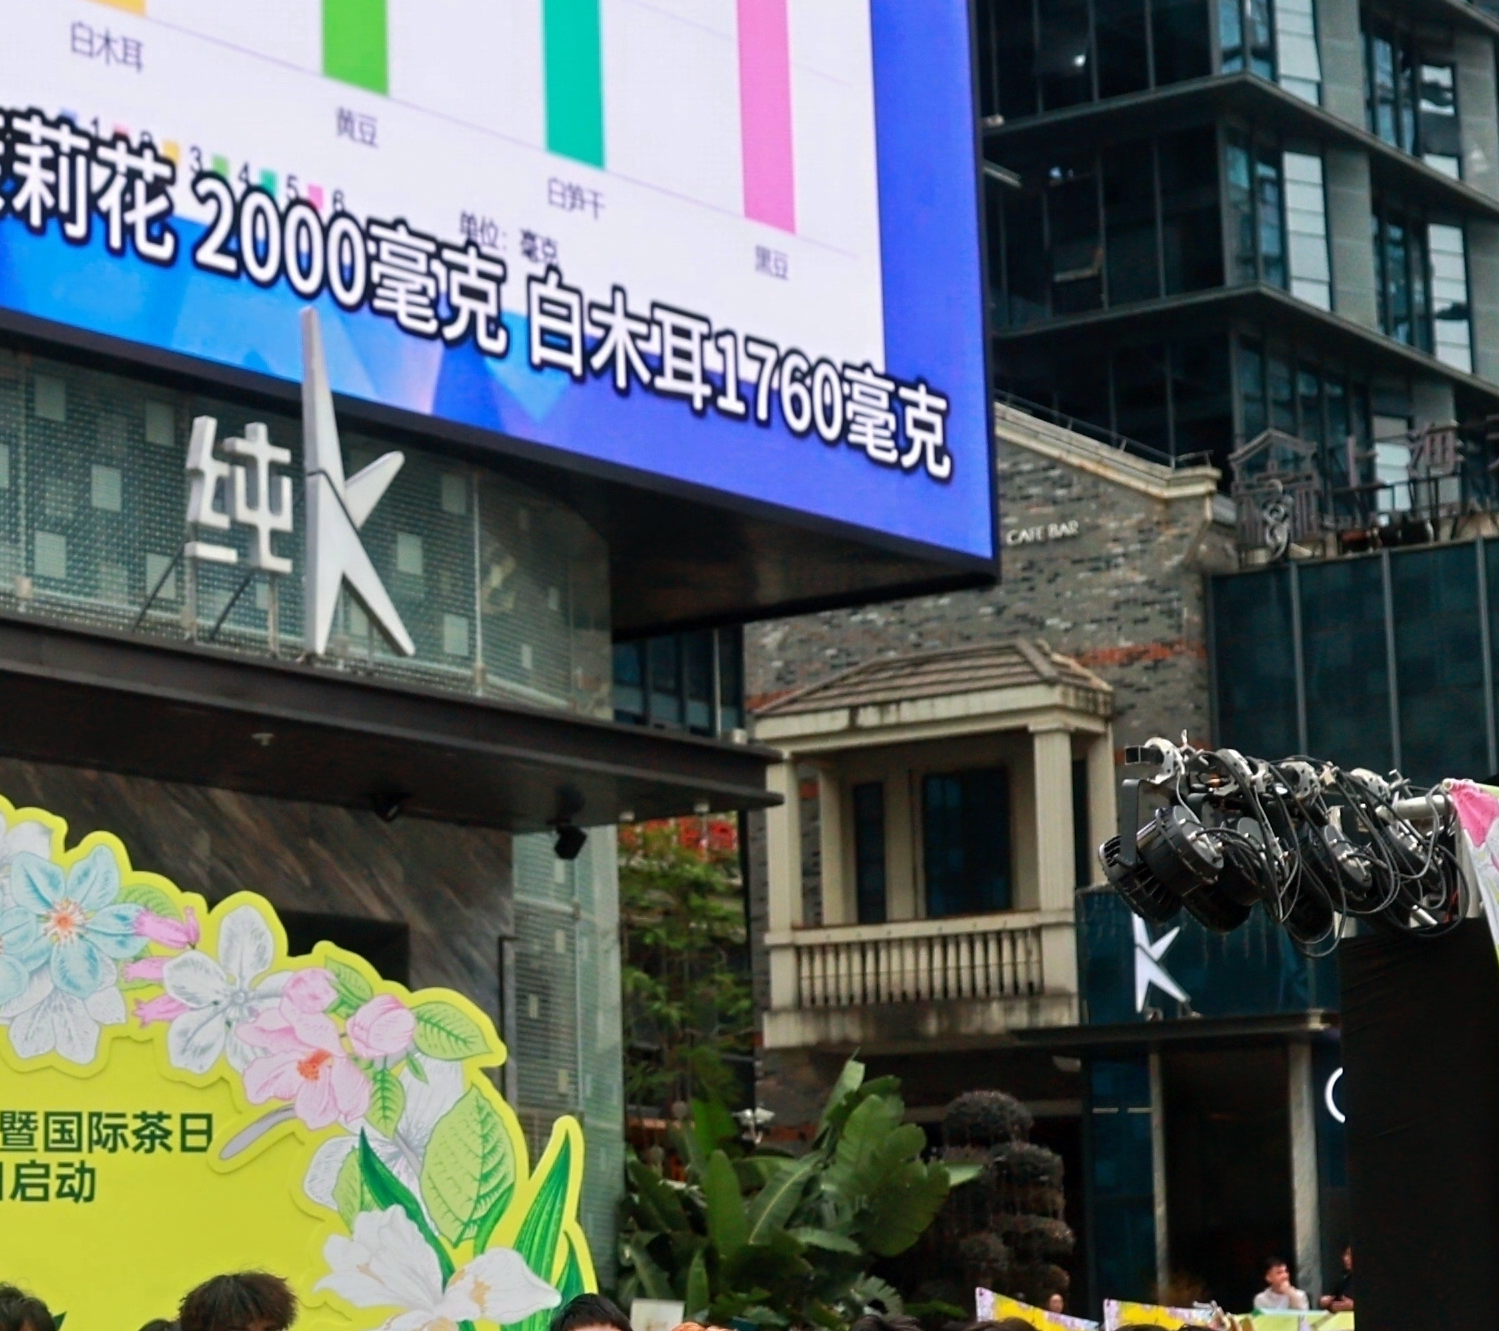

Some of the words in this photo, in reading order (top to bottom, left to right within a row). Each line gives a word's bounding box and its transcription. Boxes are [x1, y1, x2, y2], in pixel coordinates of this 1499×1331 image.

[69, 19, 146, 72] 白木耳
[335, 107, 380, 149] 黄豆
[193, 165, 511, 358] 2000毫克
[525, 270, 953, 484] 白木耳1760毫克
